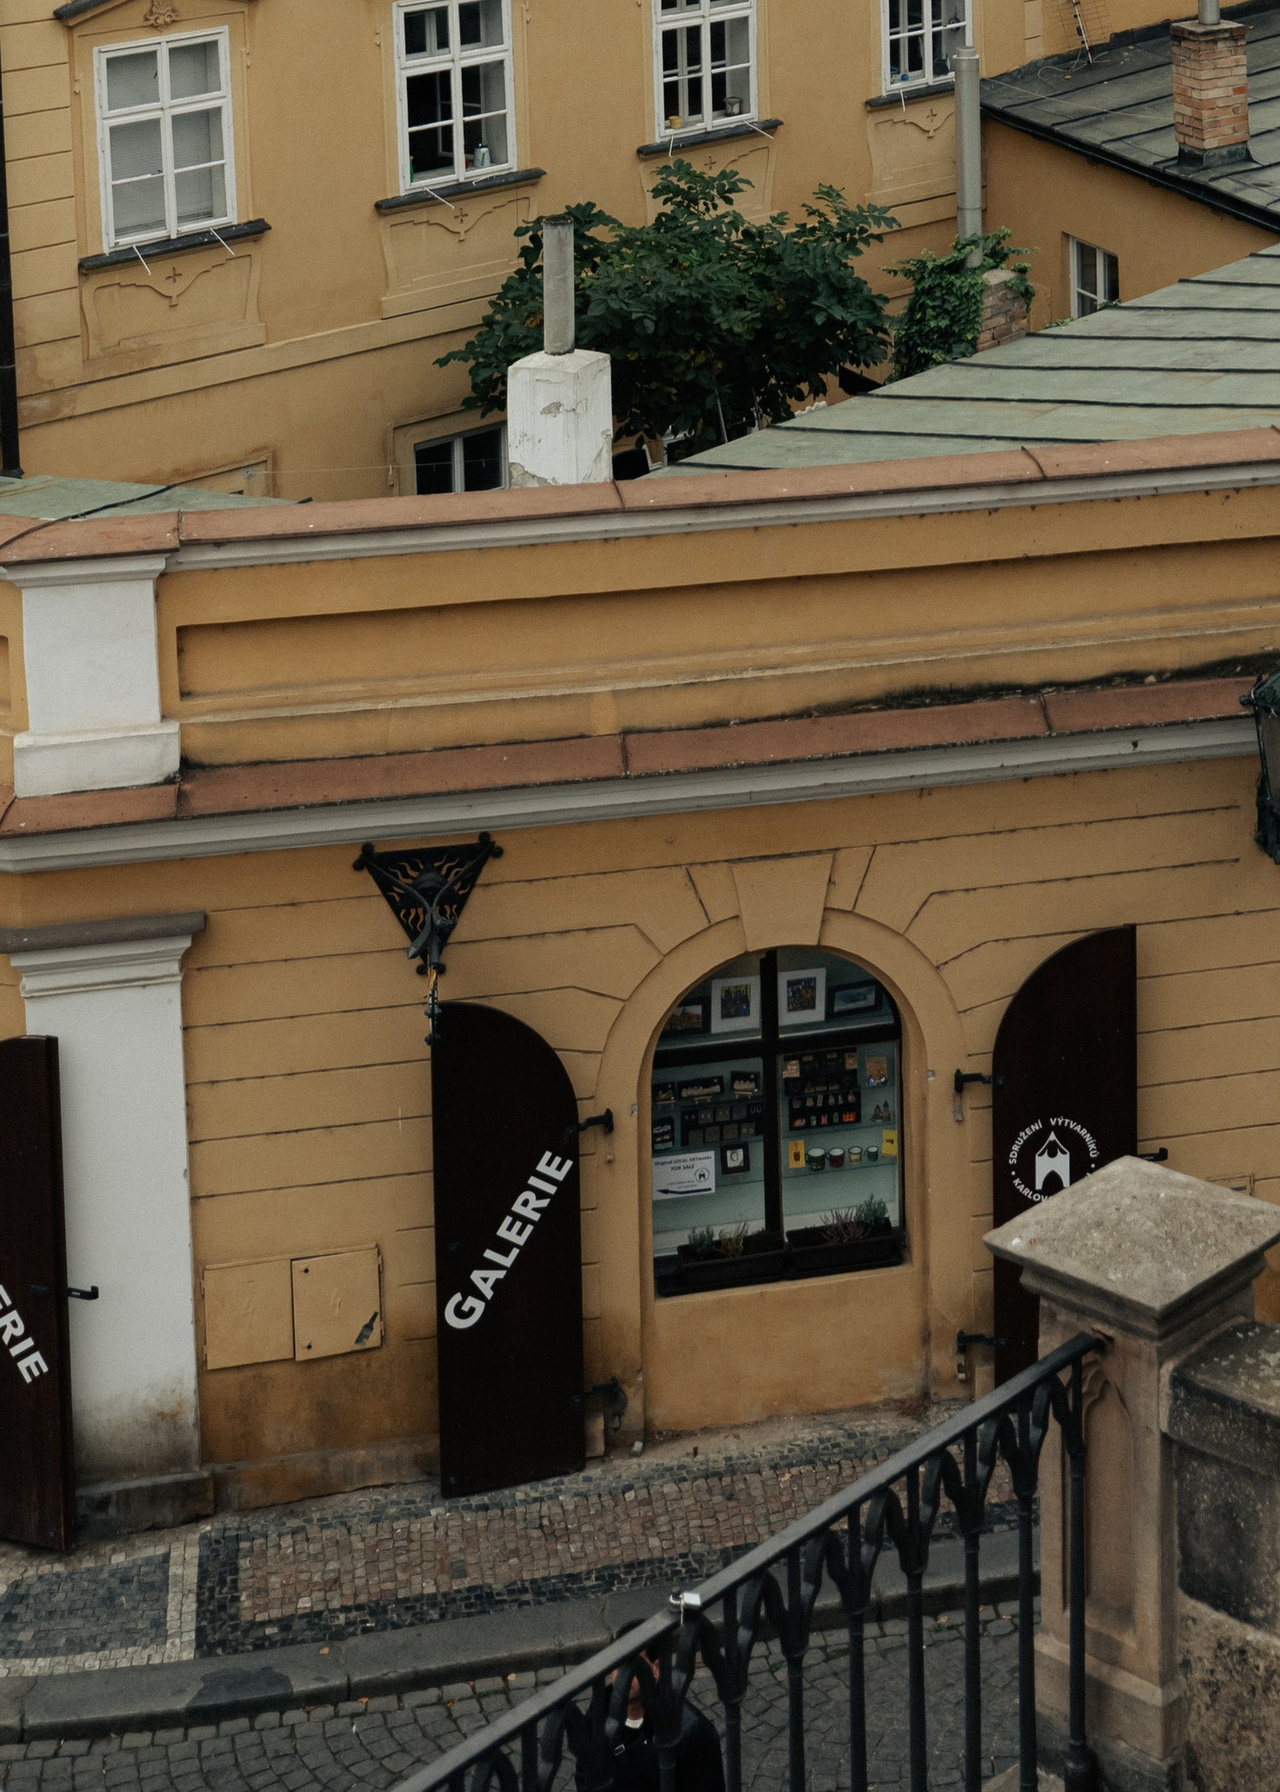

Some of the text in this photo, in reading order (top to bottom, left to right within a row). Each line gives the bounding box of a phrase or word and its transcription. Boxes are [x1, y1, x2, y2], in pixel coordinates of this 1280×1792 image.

[1009, 1116, 1100, 1165] SDRUŽENÍ VÝTVARNÍKŮ
[1013, 1177, 1051, 1202] KARLOV
[444, 1150, 574, 1329] GALERIE
